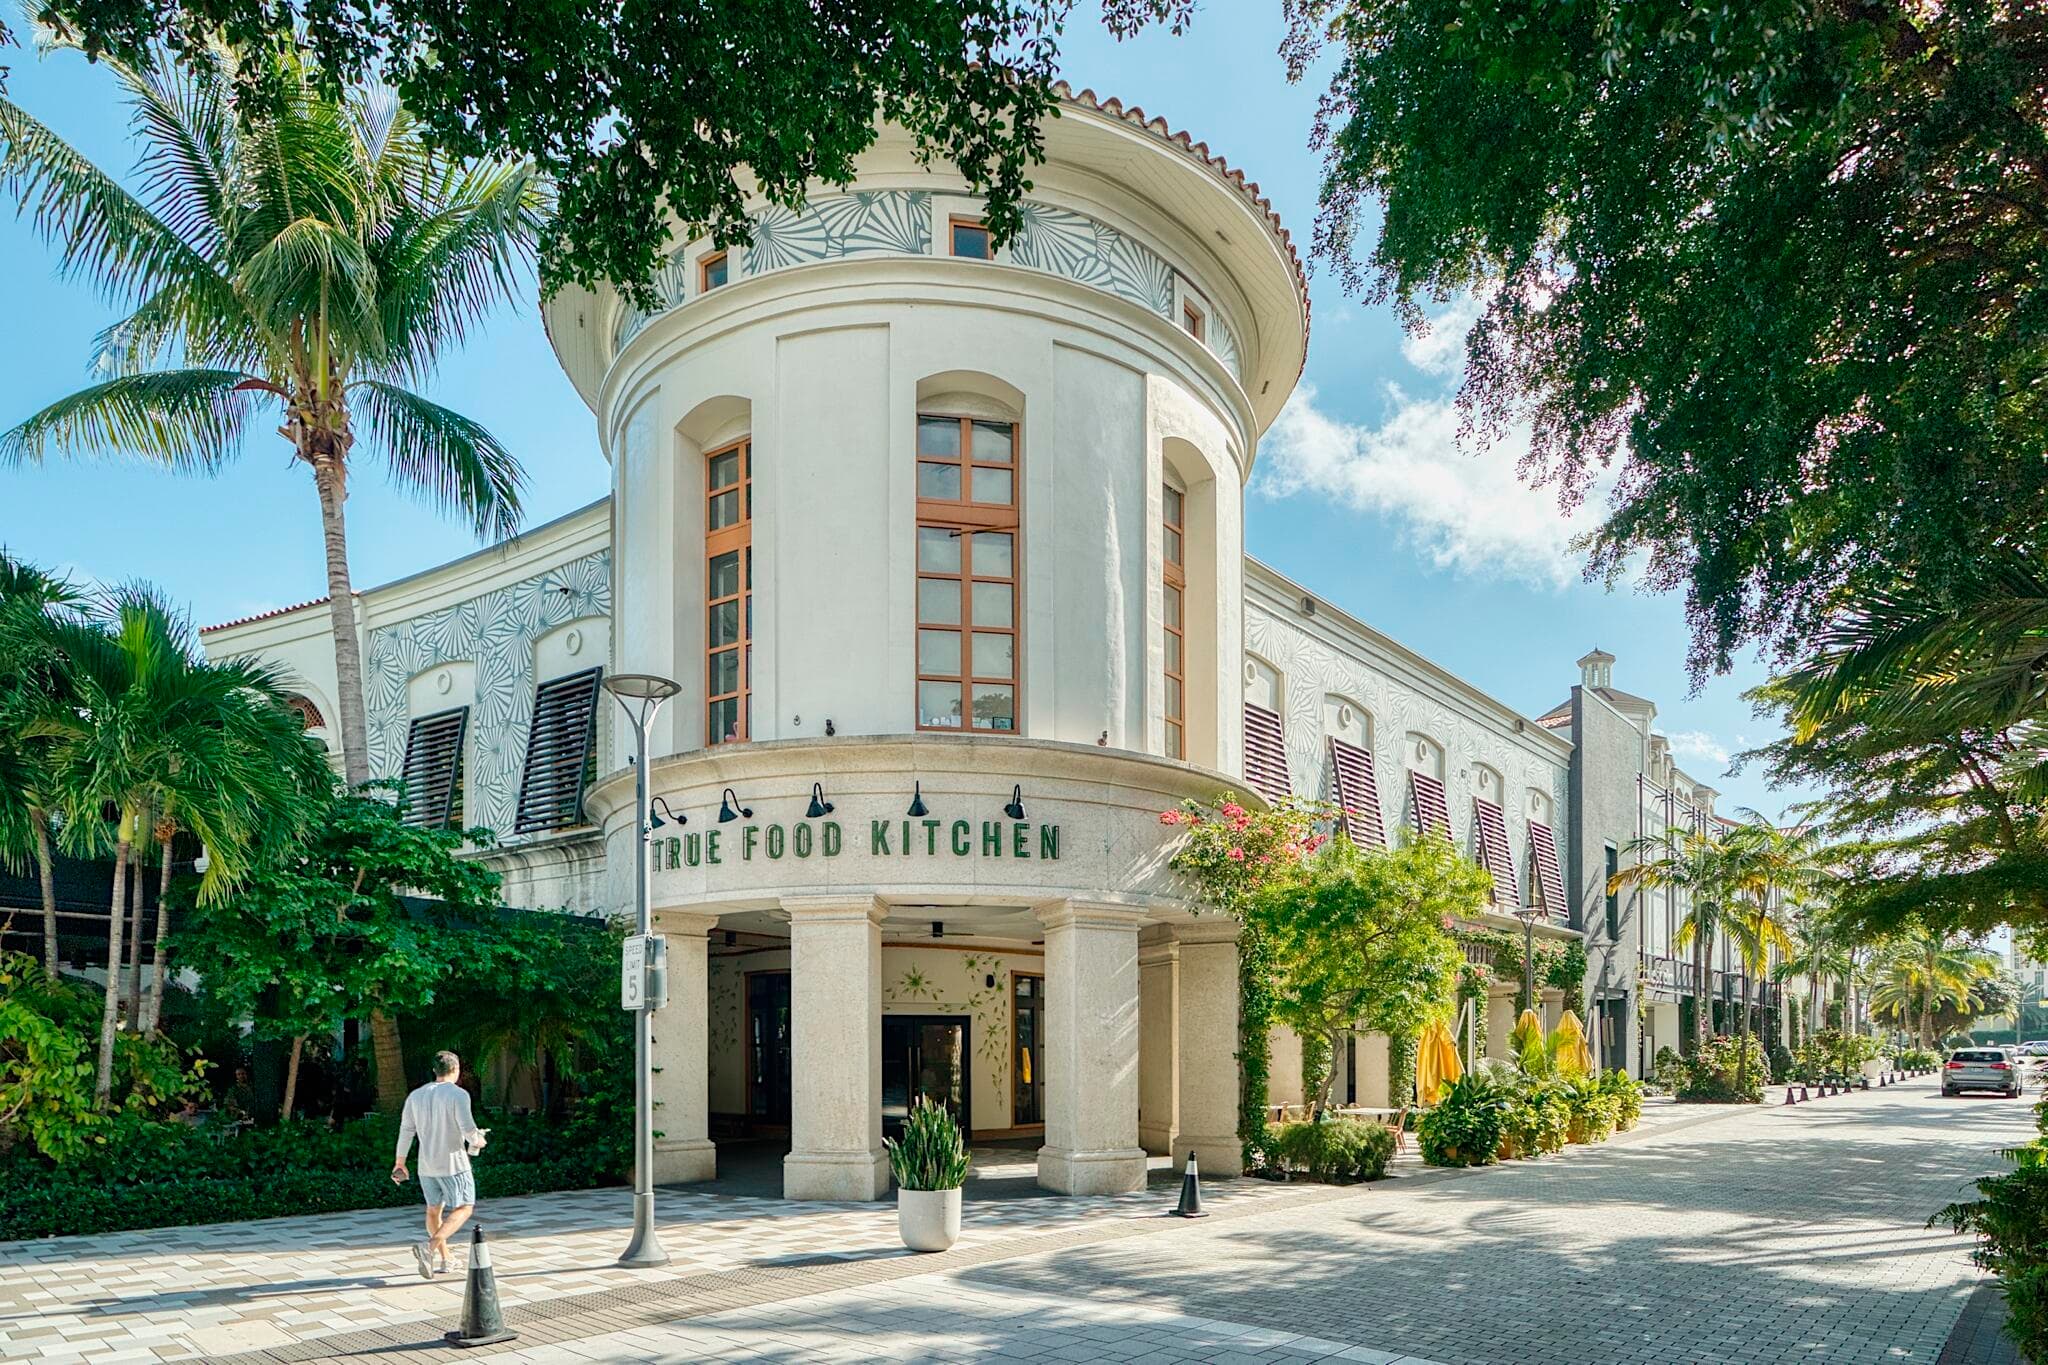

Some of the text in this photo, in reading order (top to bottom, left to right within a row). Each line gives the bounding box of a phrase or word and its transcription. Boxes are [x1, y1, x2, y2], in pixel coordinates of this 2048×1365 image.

[650, 819, 1060, 872] TRUE FOOD KITCHEN
[625, 944, 642, 956] SPEED
[625, 959, 640, 971] LIMIT
[629, 975, 637, 1001] 5
